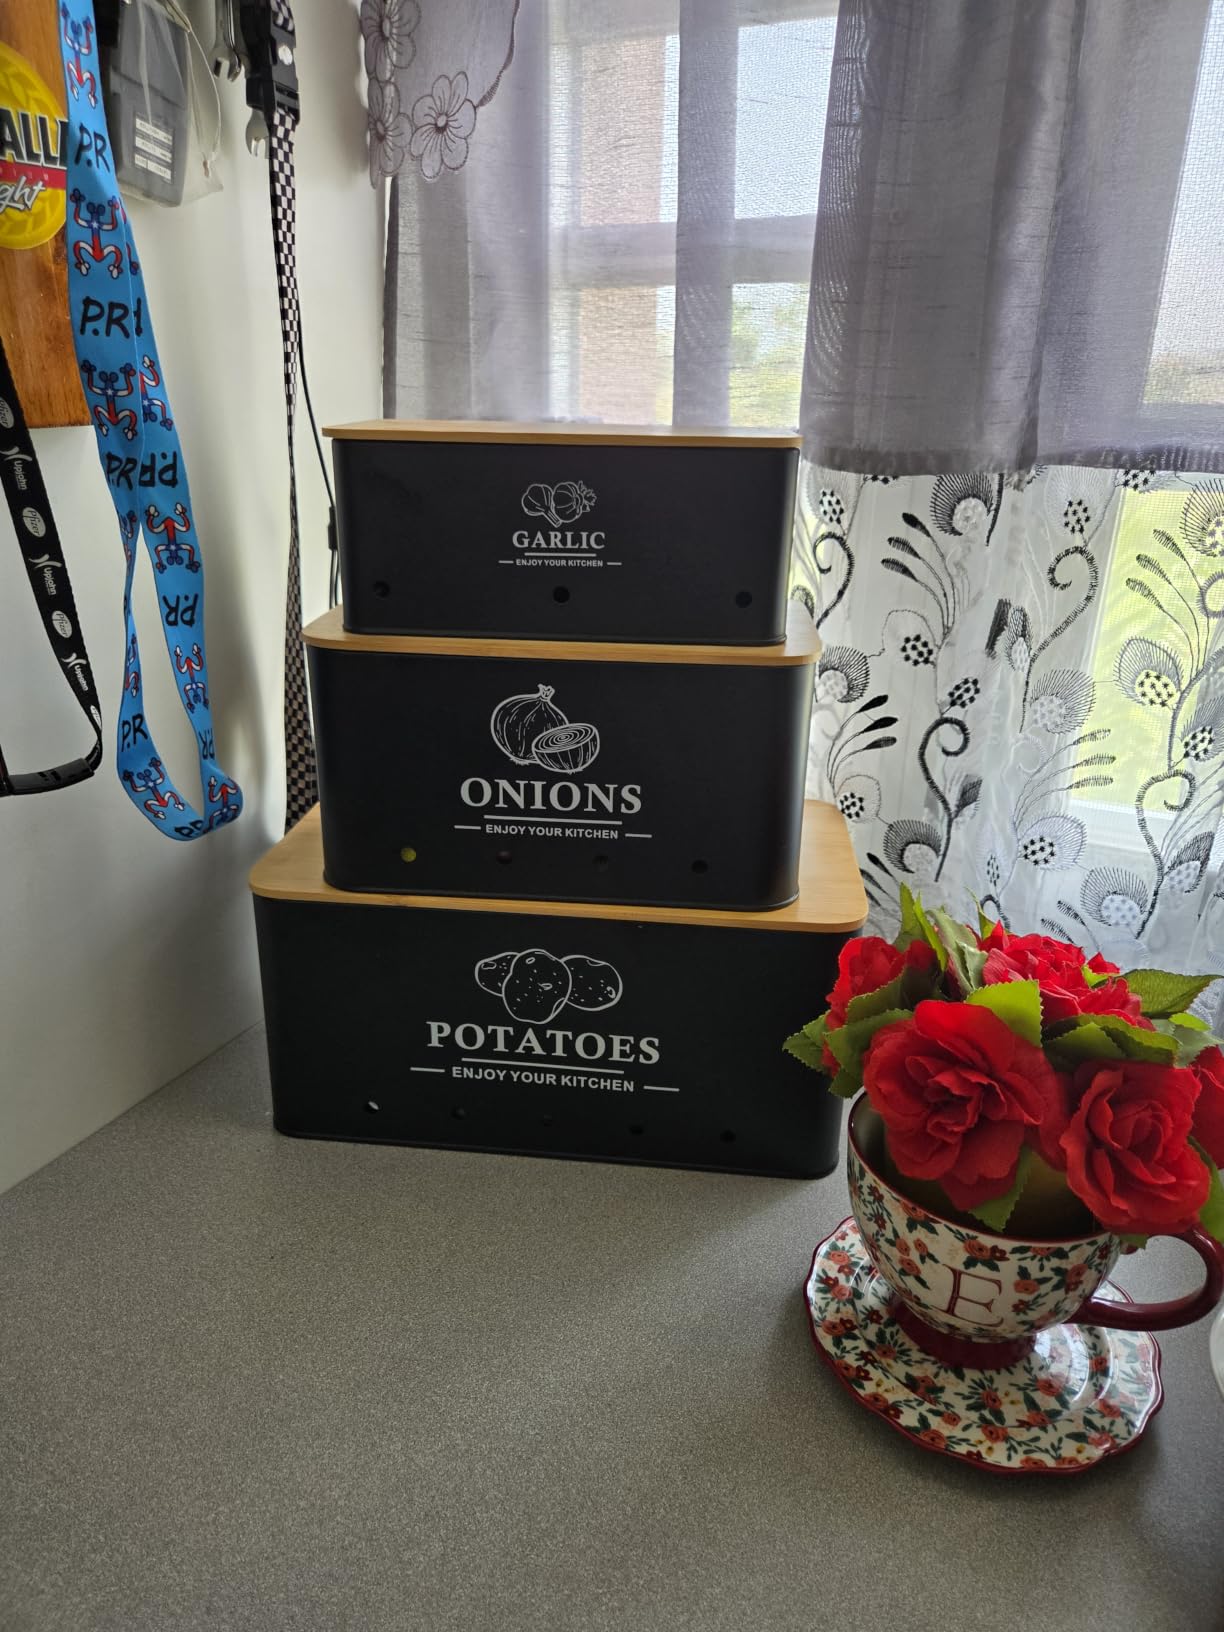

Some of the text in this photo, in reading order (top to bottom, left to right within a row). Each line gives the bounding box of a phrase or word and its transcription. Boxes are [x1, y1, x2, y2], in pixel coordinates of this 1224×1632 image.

[512, 530, 605, 549] GARLIC
[515, 558, 604, 567] ENJOY YOUR KITCHEN
[460, 777, 642, 814] ONIONS
[485, 823, 618, 839] ENJOY YOUR KITCHEN
[426, 1021, 660, 1065] POTATOES
[452, 1066, 635, 1092] ENJOY YOUR KITCHEN
[931, 1263, 1004, 1328] E
